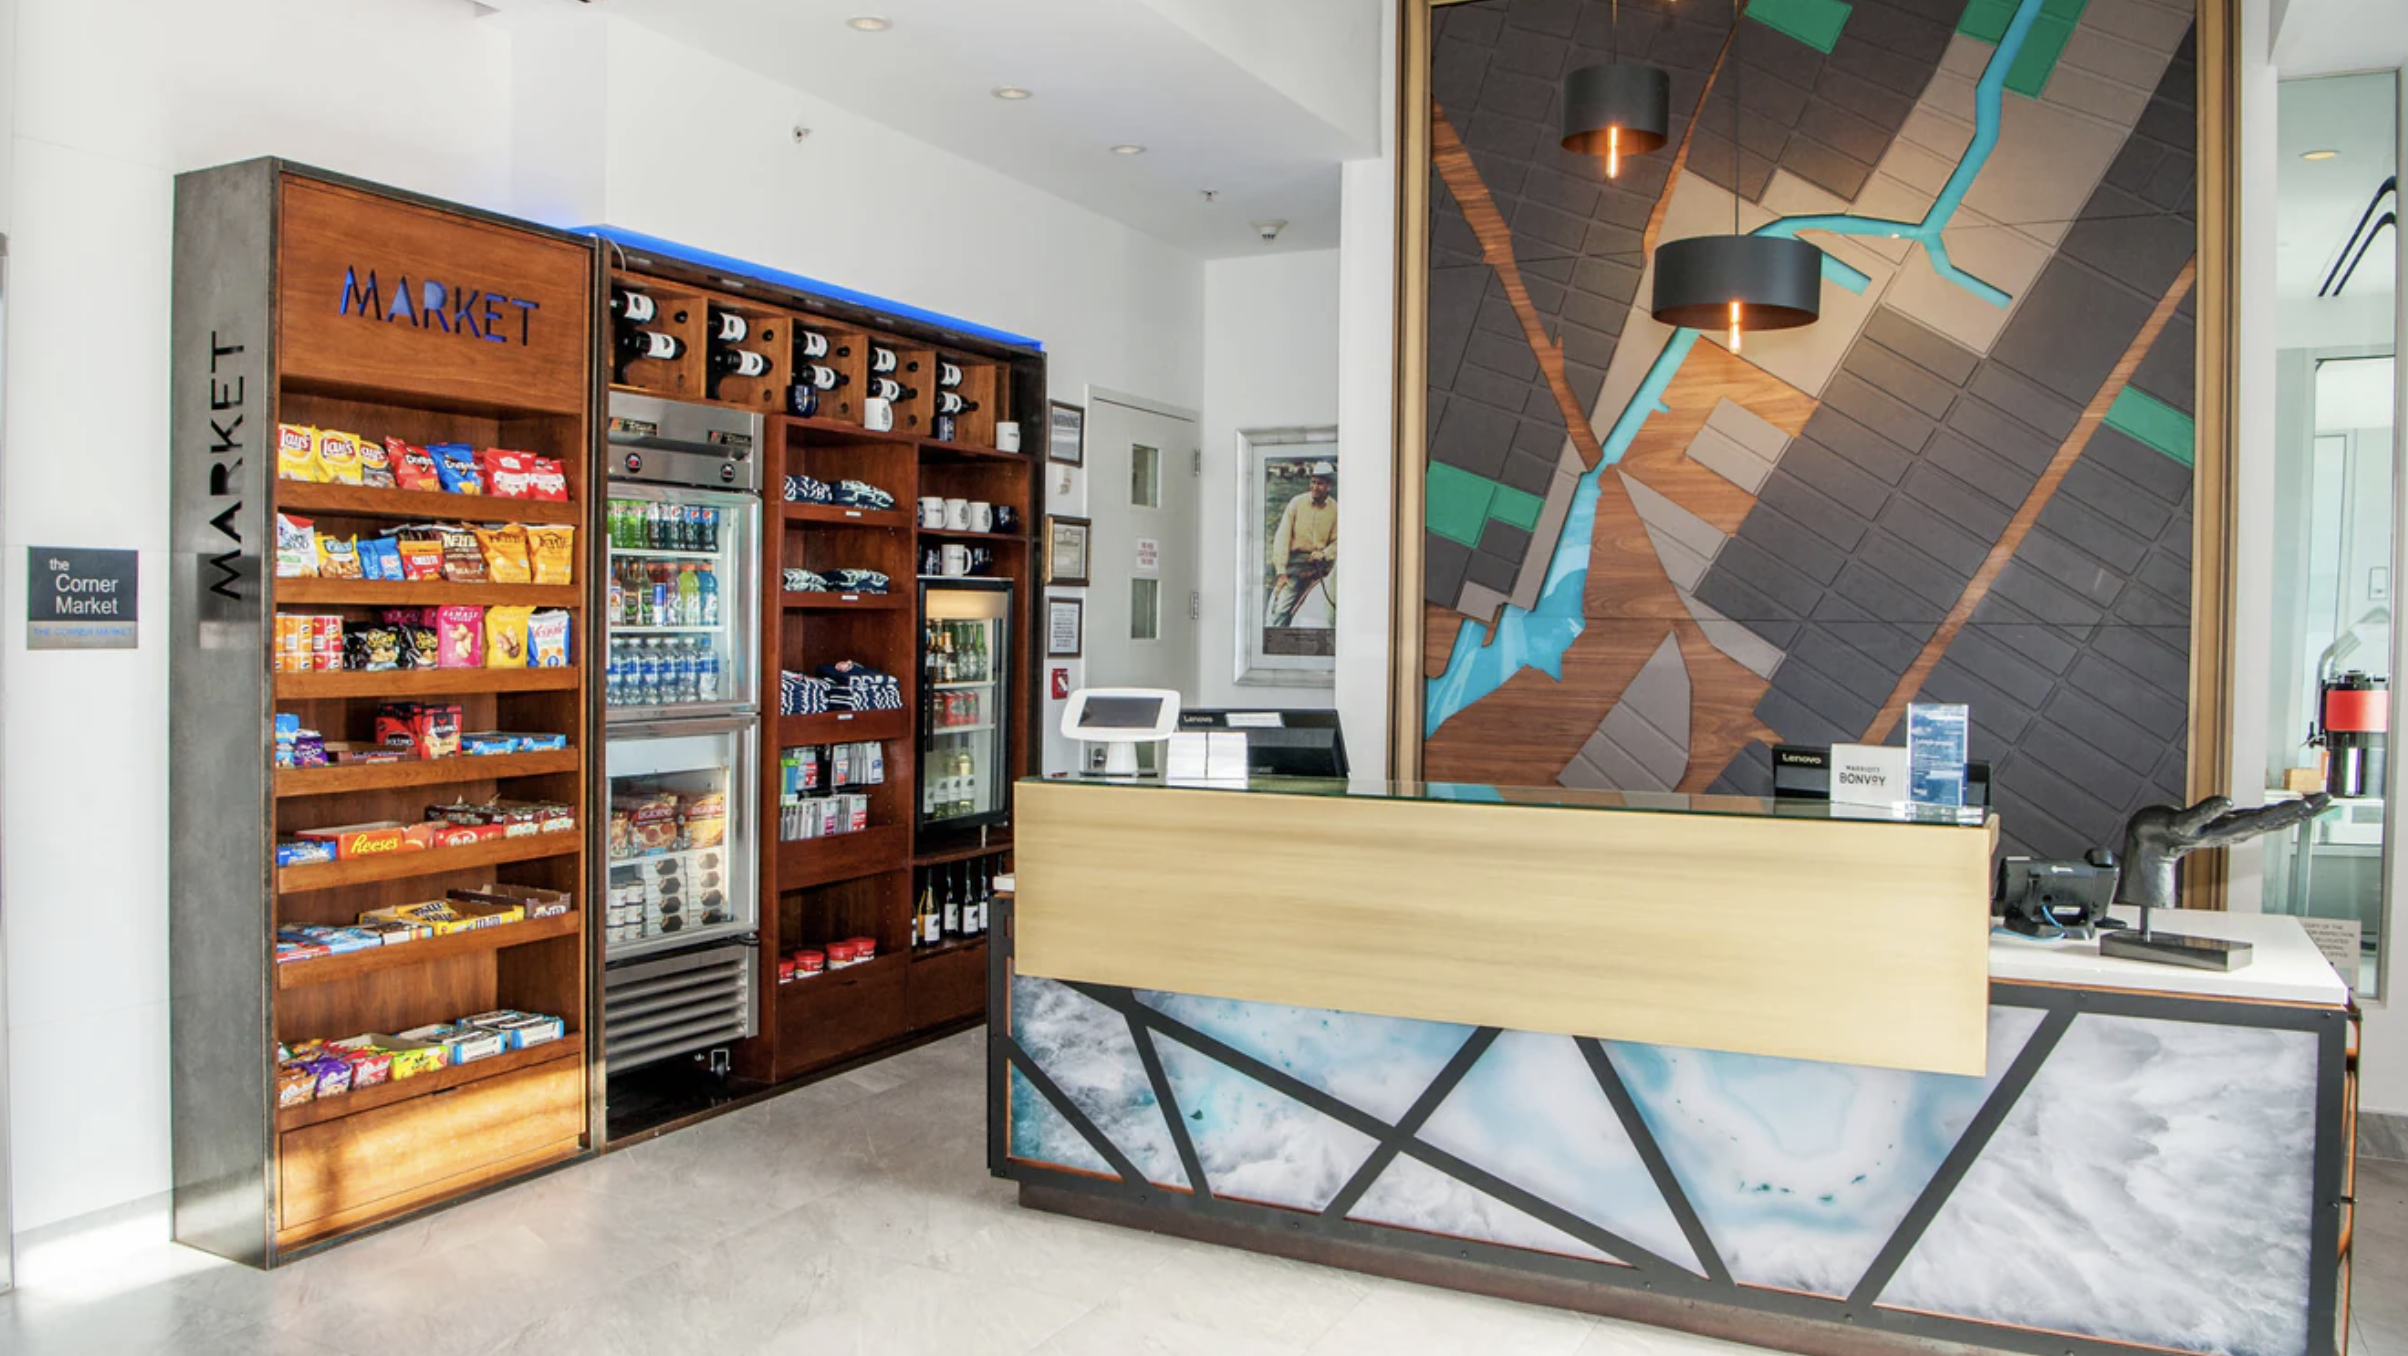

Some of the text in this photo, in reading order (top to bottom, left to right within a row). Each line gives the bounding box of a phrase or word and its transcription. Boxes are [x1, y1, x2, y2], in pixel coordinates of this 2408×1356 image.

[339, 264, 540, 346] MARKET
[322, 436, 355, 458] Lay's
[361, 446, 387, 461] ay's
[209, 331, 245, 600] MARKET
[49, 558, 70, 571] the
[55, 573, 119, 593] Corner
[55, 595, 119, 615] Market
[1183, 715, 1214, 724] Lenovo
[1782, 753, 1822, 765] Lenovo
[1839, 772, 1887, 786] BONVOY
